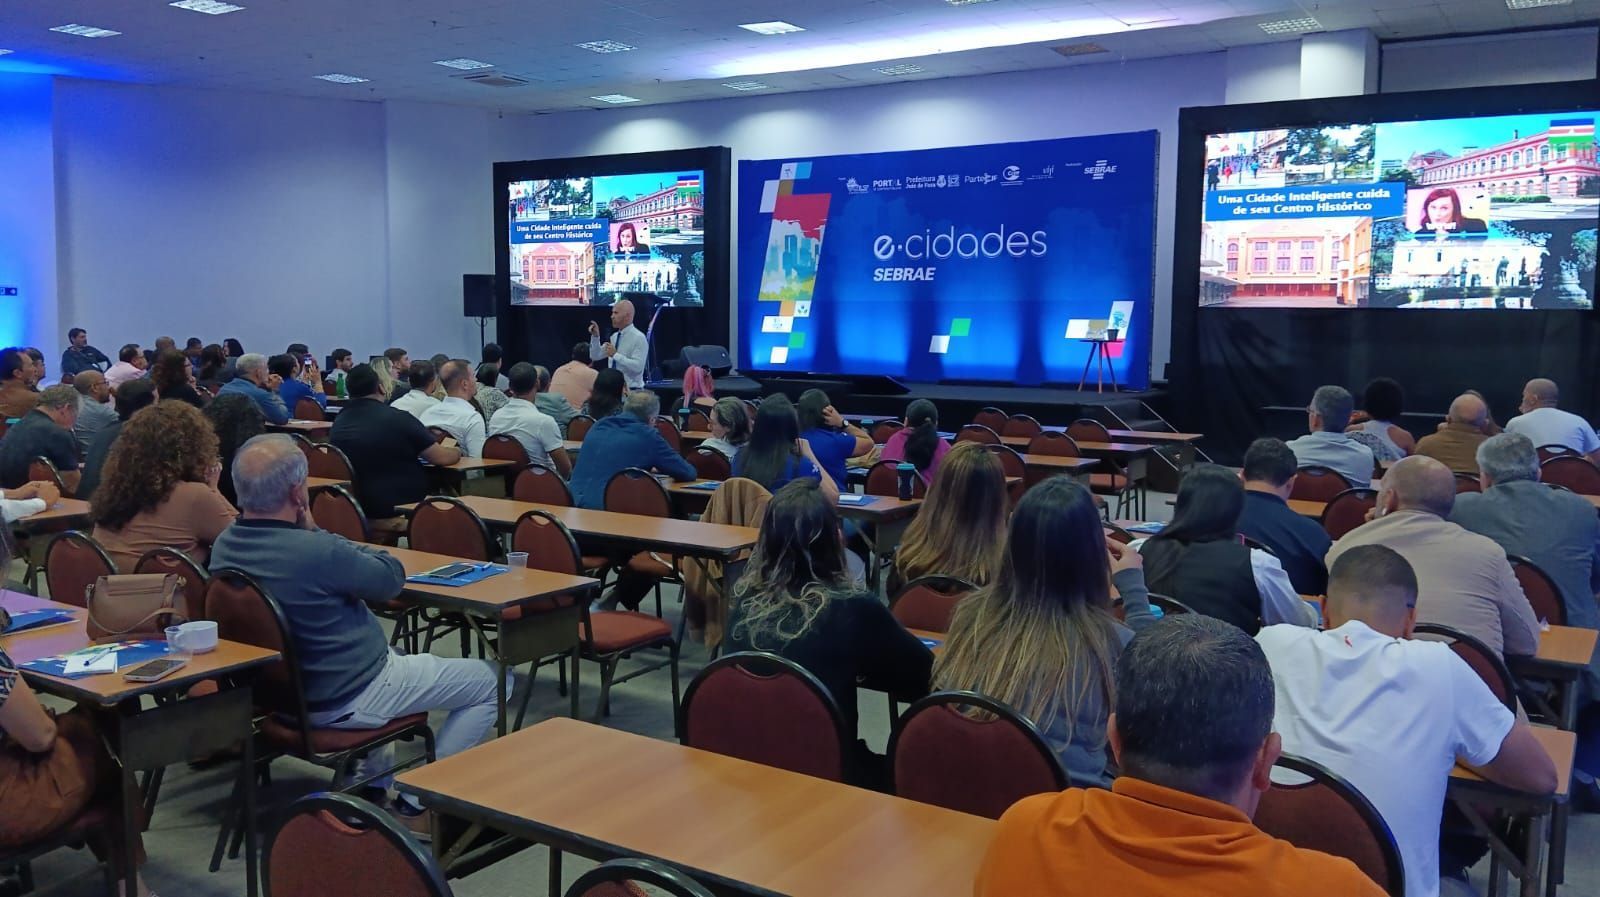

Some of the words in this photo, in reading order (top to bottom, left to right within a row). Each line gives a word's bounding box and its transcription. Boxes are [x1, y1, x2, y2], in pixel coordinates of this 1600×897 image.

[1084, 165, 1117, 174] SEBRAE
[1218, 195, 1243, 204] Uma
[1245, 193, 1286, 203] Cidade
[1289, 191, 1354, 202] Inteligente
[1356, 188, 1391, 199] cuida
[1233, 205, 1247, 215] de
[1250, 206, 1271, 214] seu
[1273, 203, 1314, 214] Centro
[1316, 201, 1373, 212] Histórico
[530, 224, 551, 232] Cidade
[551, 223, 584, 231] Inteligente
[584, 222, 602, 230] cuida
[565, 231, 593, 239] Histórico
[873, 266, 936, 282] SEBRAE
